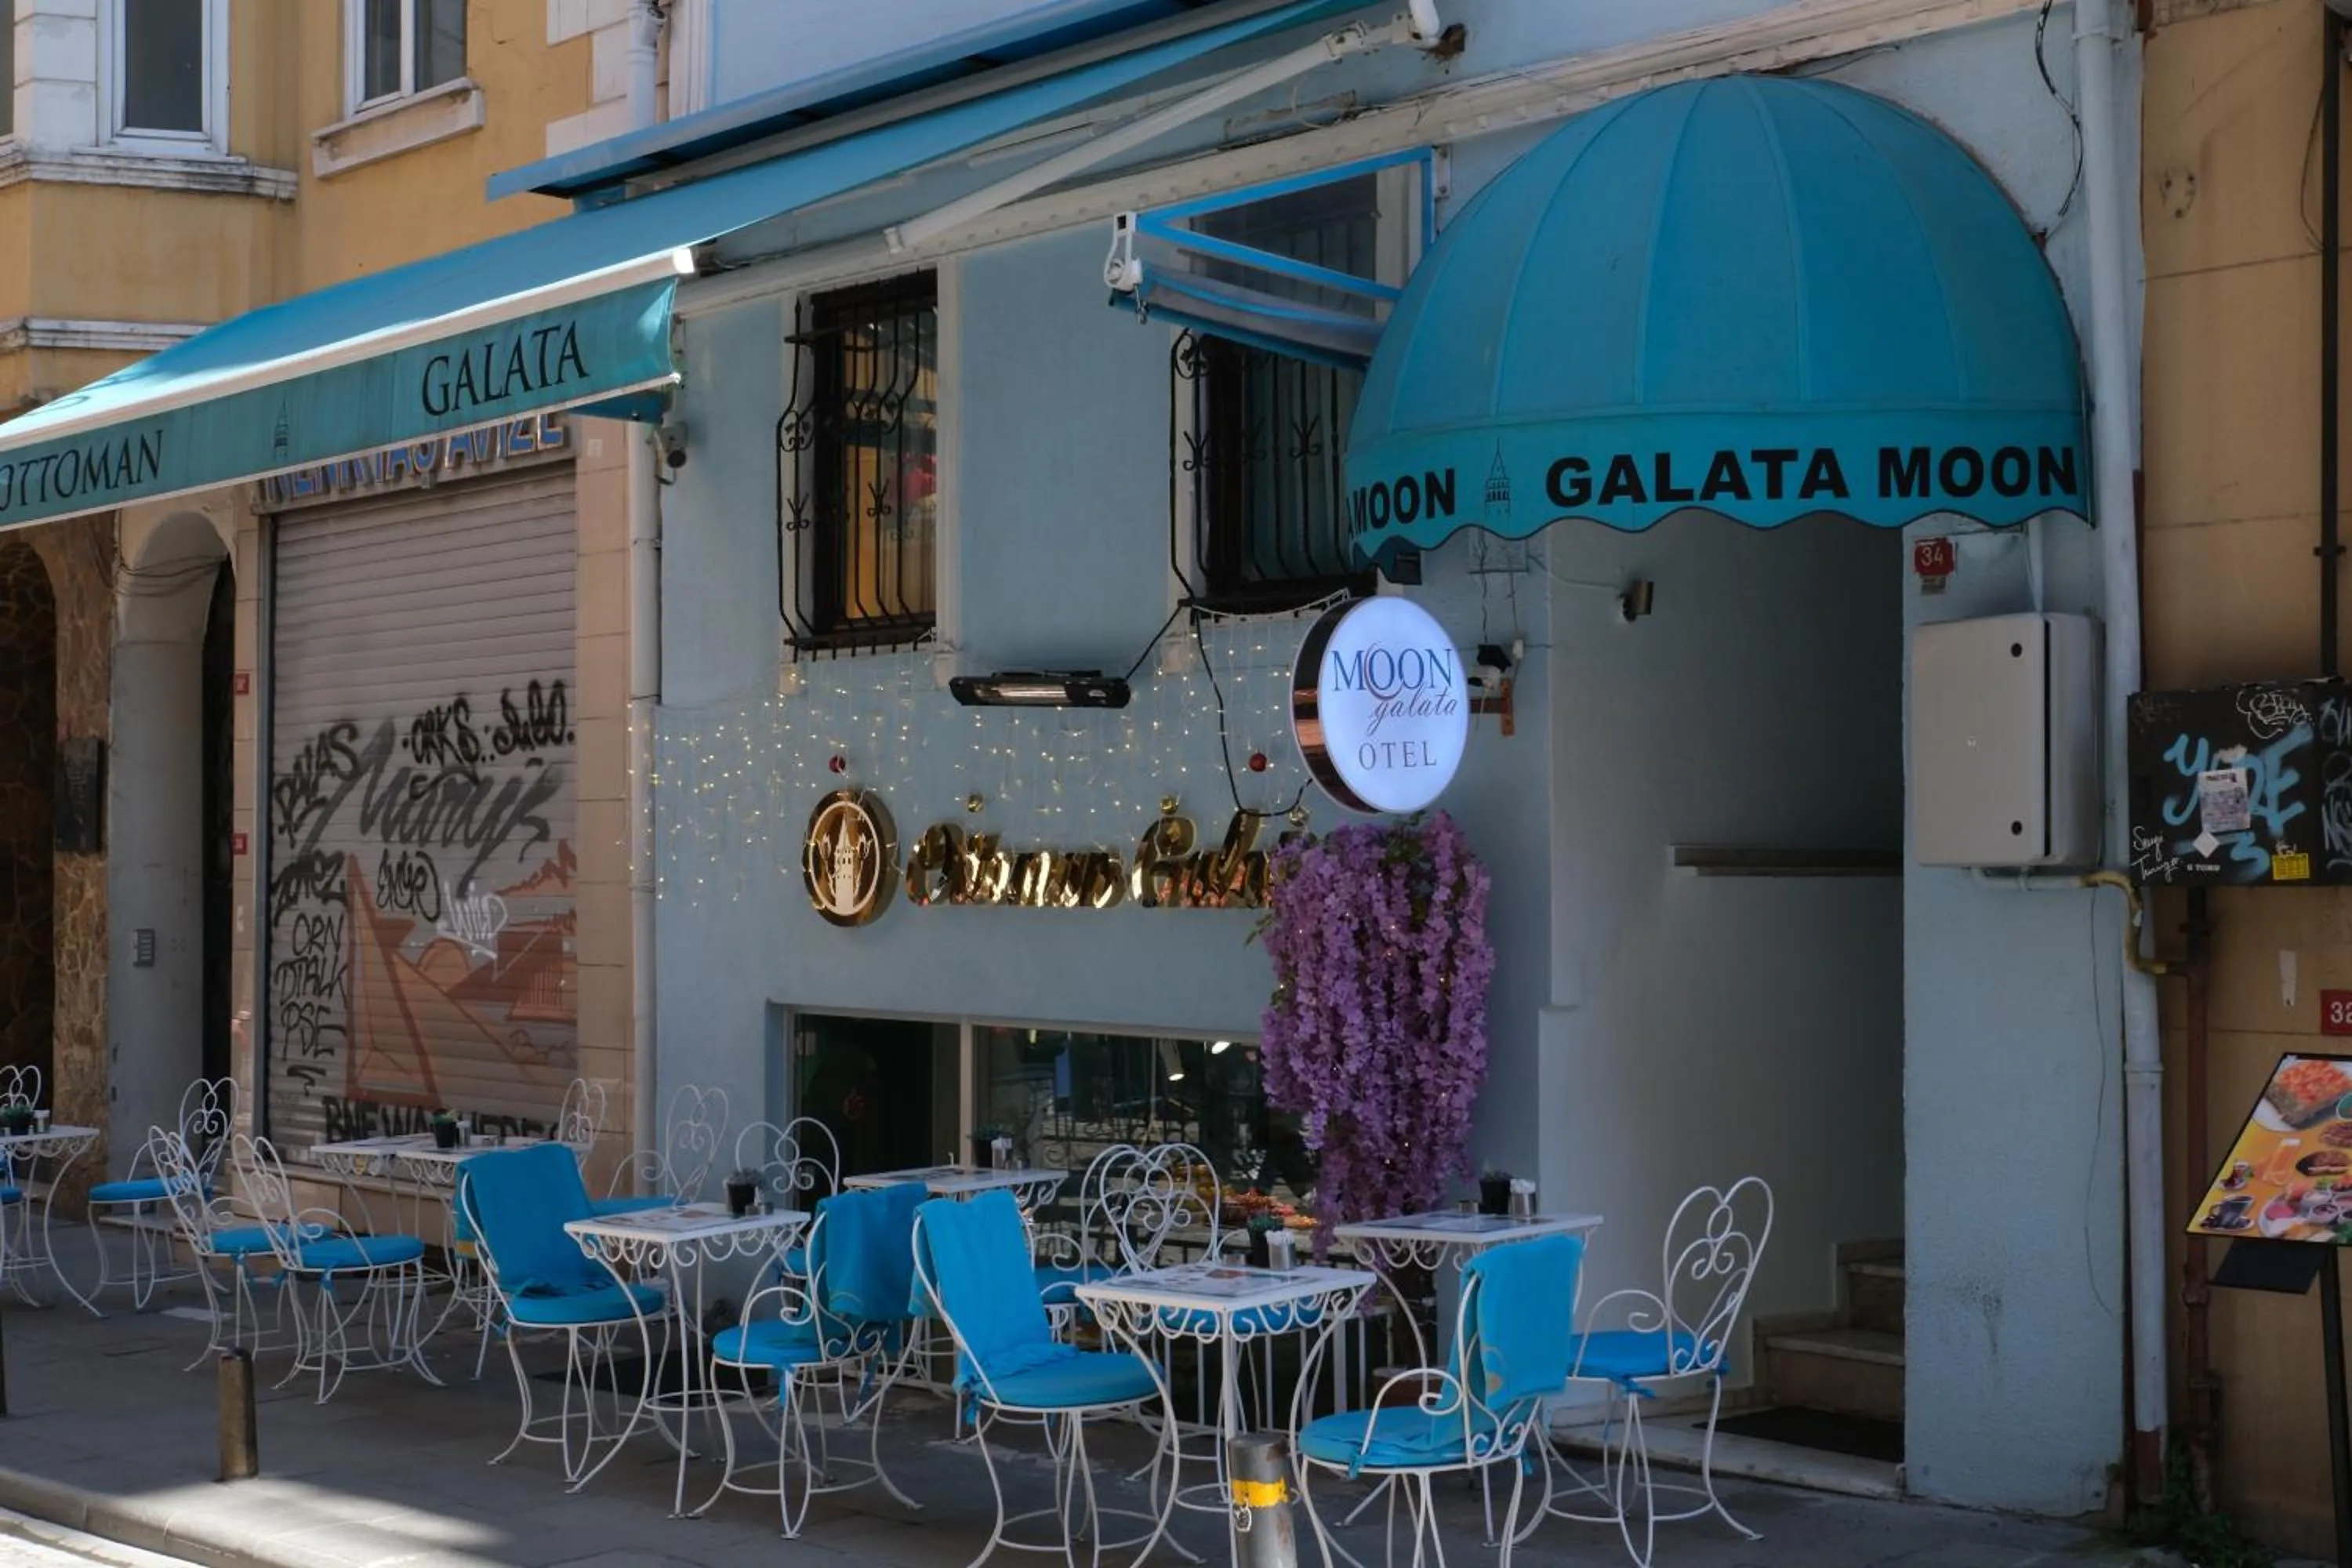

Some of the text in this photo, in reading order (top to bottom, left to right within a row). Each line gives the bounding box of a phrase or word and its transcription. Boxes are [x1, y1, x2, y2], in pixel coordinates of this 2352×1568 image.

[422, 320, 590, 416] GALATA
[1353, 467, 1456, 535] MOON
[1546, 445, 2078, 508] GALATA MOON
[1920, 546, 1944, 566] 34
[1330, 648, 1453, 691] MOON
[1367, 680, 1458, 737] galata
[1359, 739, 1438, 771] OTEL
